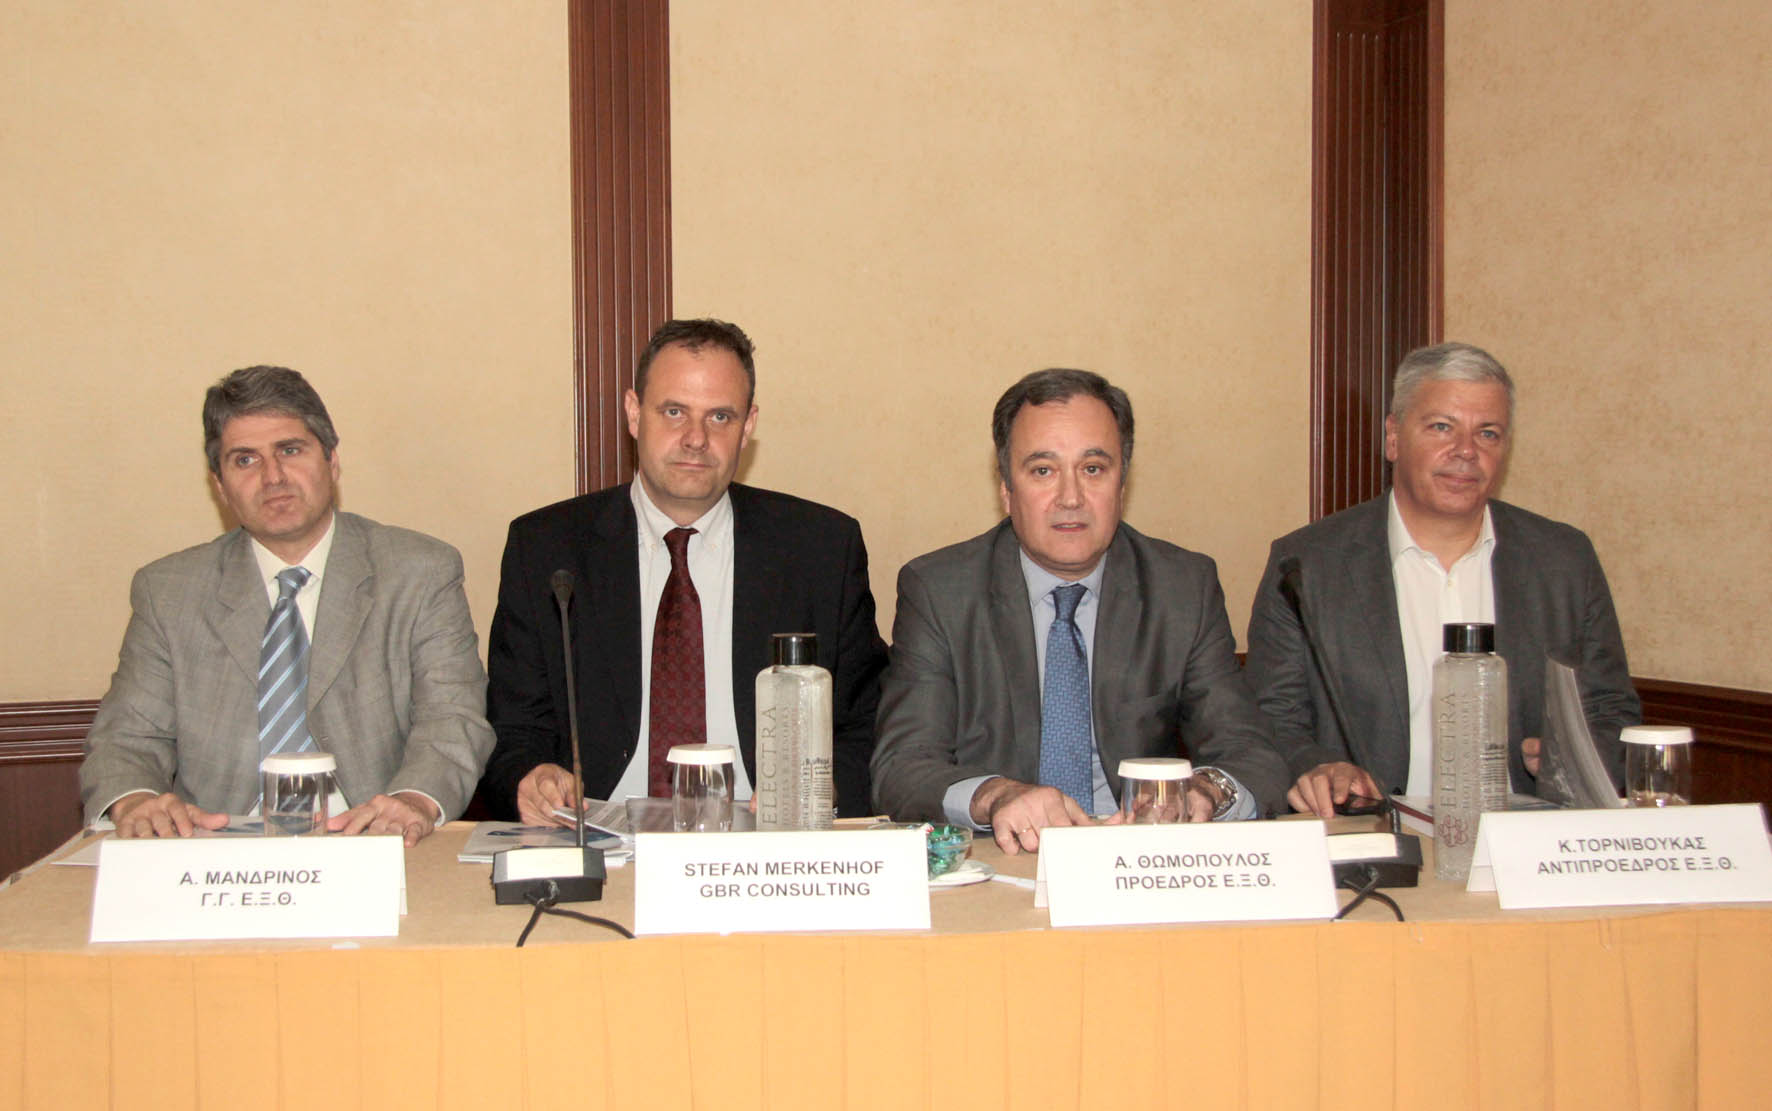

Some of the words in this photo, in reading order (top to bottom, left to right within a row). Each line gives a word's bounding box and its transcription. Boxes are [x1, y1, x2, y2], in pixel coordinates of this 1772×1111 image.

[1440, 692, 1457, 809] ELECTRA
[760, 705, 777, 825] ELECTRA
[1558, 836, 1708, 853] Κ.ΤΟΡΝΙΒΟΥΚΑΣ
[684, 862, 759, 877] STEFAN
[765, 860, 884, 876] MERKENHOF
[1114, 855, 1132, 869] Α.
[1137, 852, 1273, 869] ΘΩΜΟΠΟΥΛΟΣ
[1537, 857, 1679, 875] ΑΝΤΙΠΡΟΕΔΡΟΣ
[1684, 856, 1738, 871] Ε.Ξ.Θ.
[179, 871, 198, 886] Α.
[205, 869, 322, 885] ΜΑΝΔΡΙΝΟΣ
[1115, 874, 1218, 890] ΠΡΟΕΔΡΟΣ
[1223, 873, 1276, 888] Ε.Ξ.Θ.
[699, 883, 741, 898] GBR
[747, 882, 871, 898] CONSULTING
[240, 891, 297, 907] Ε.Ξ.Θ.
